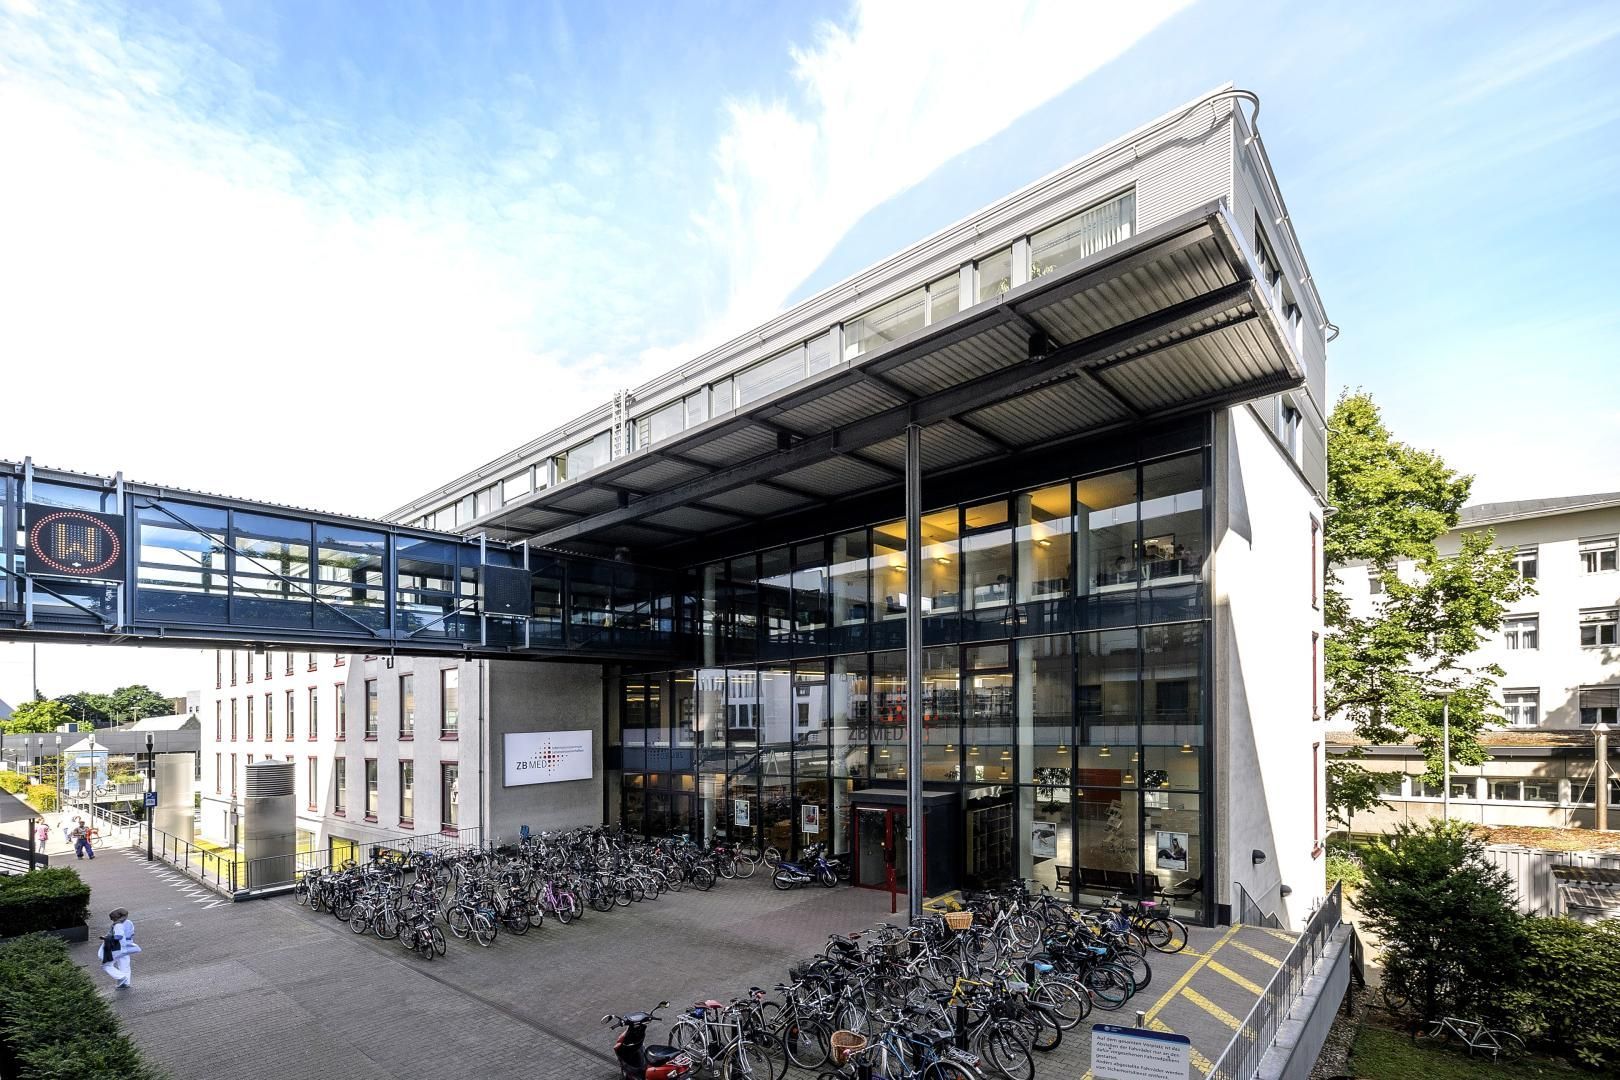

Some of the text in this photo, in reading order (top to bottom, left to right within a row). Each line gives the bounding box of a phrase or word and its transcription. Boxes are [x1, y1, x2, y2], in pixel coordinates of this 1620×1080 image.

[848, 727, 904, 740] ZB MED
[516, 760, 548, 770] ZB MED
